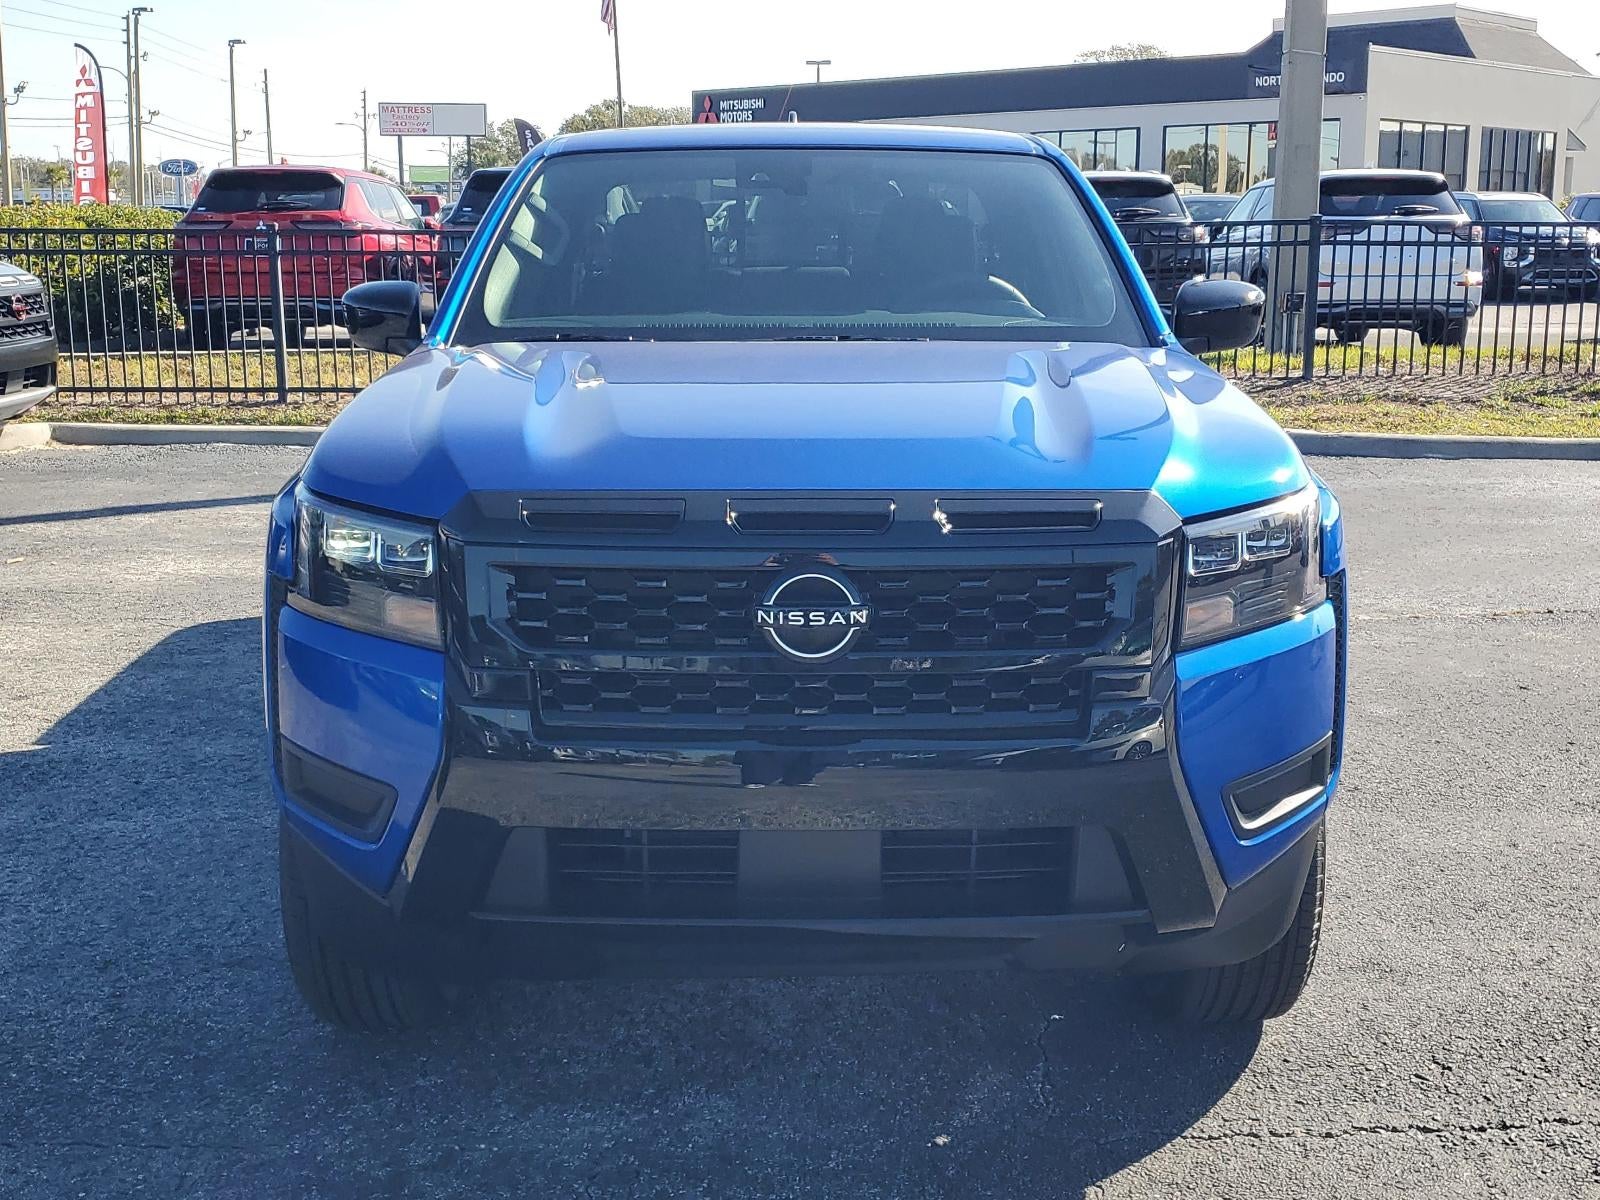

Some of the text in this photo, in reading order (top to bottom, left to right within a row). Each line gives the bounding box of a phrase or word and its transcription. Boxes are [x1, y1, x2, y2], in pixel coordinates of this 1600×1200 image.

[1255, 72, 1345, 87] NORT NDO
[381, 105, 432, 114] MATTRESS
[719, 98, 764, 111] MITSUBISHI
[720, 110, 753, 122] MOTORS
[757, 609, 868, 626] NISSAN
